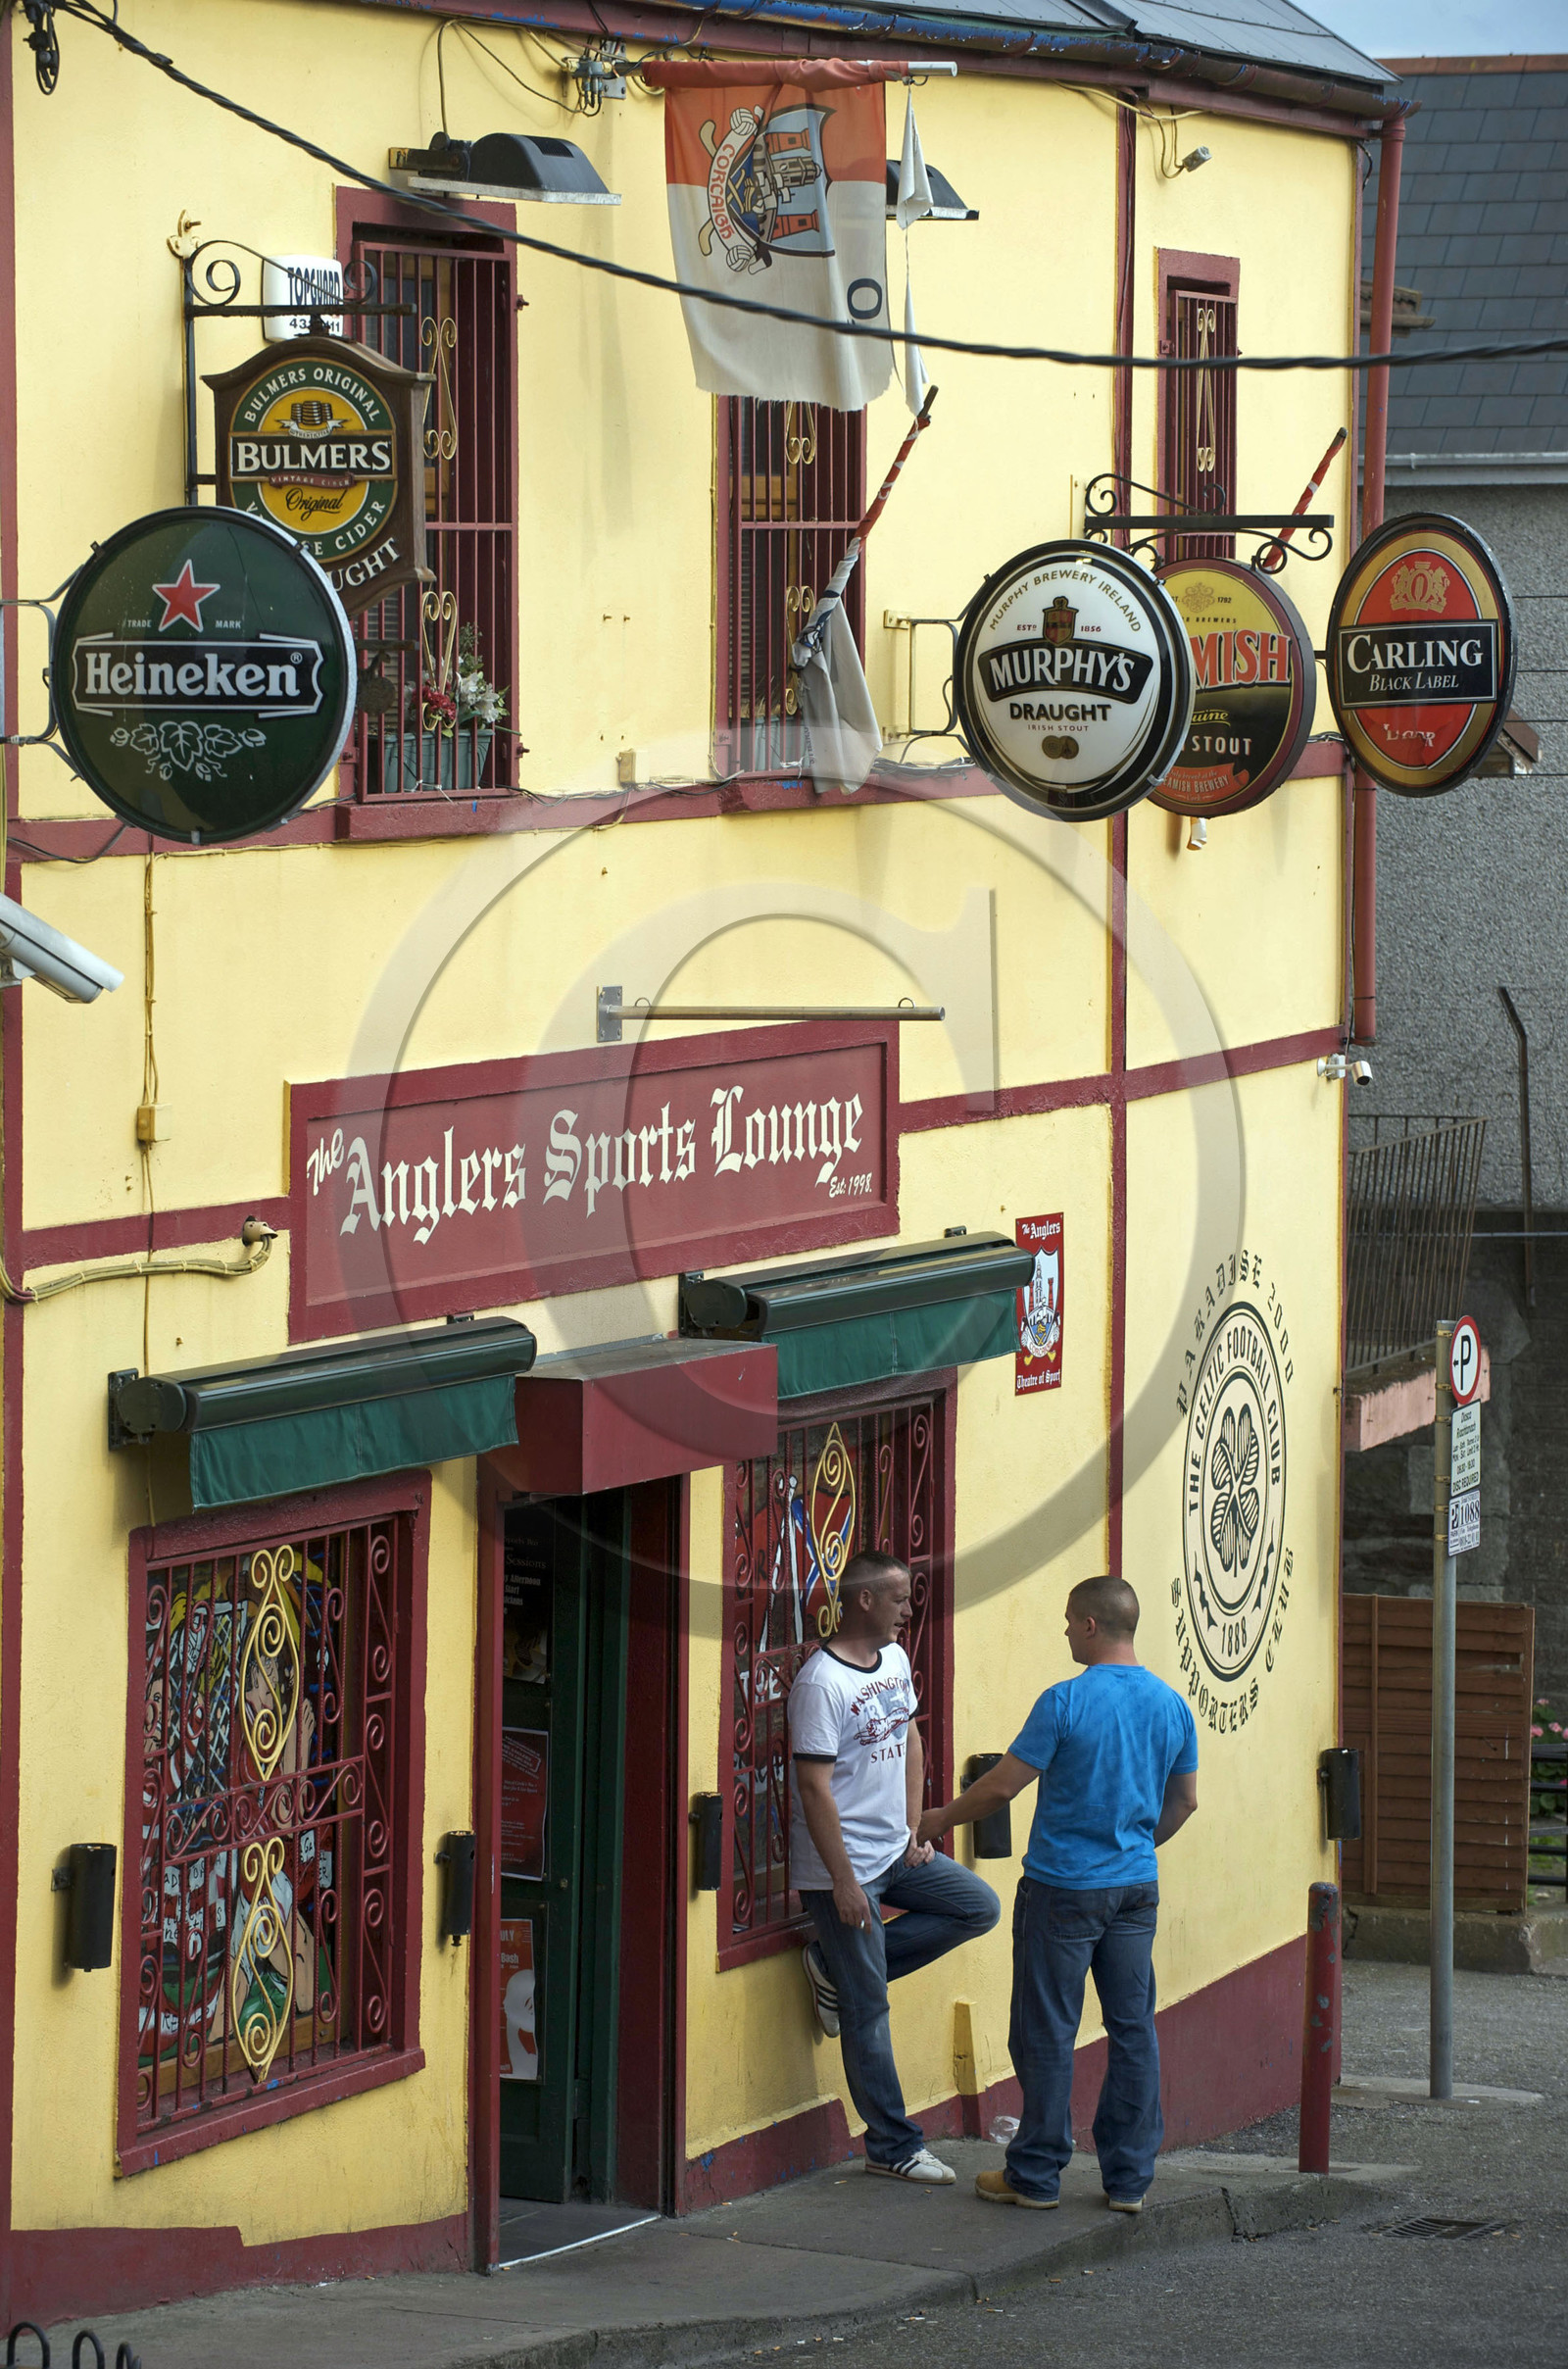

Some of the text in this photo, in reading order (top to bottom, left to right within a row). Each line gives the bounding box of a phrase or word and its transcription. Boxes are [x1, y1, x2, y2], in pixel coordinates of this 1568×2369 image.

[287, 267, 341, 306] TOPGUARD
[244, 367, 381, 423] BULMERS ORIGINAL
[236, 440, 391, 472] BULMERS
[285, 487, 348, 522] Original
[334, 500, 386, 551] CIDER
[989, 568, 1142, 633] MURPHY BREWERY IRELAND
[126, 619, 242, 629] TRADE MARK
[1080, 624, 1102, 633] 1856
[989, 646, 1136, 693] MURPHY'S
[1347, 634, 1485, 674] CARLING
[1368, 671, 1460, 692] BLACK LABEL
[1009, 702, 1112, 721] DRAUGHT
[1191, 735, 1253, 756] STOUT
[1194, 773, 1230, 793] BREWERY
[306, 1084, 864, 1246] The Anglers Sports Lounge
[1029, 1219, 1061, 1241] Anglers
[1176, 1249, 1295, 1418] PARADISE 2000
[1016, 1374, 1038, 1391] Theatre
[1038, 1370, 1045, 1385] of
[1459, 1334, 1471, 1391] P
[1189, 1325, 1282, 1517] THE CELTIC FOOTBALL CLUB
[1459, 1499, 1480, 1526] 1088
[1171, 1576, 1259, 1735] SUPPORTERS
[1221, 1615, 1248, 1657] 1888
